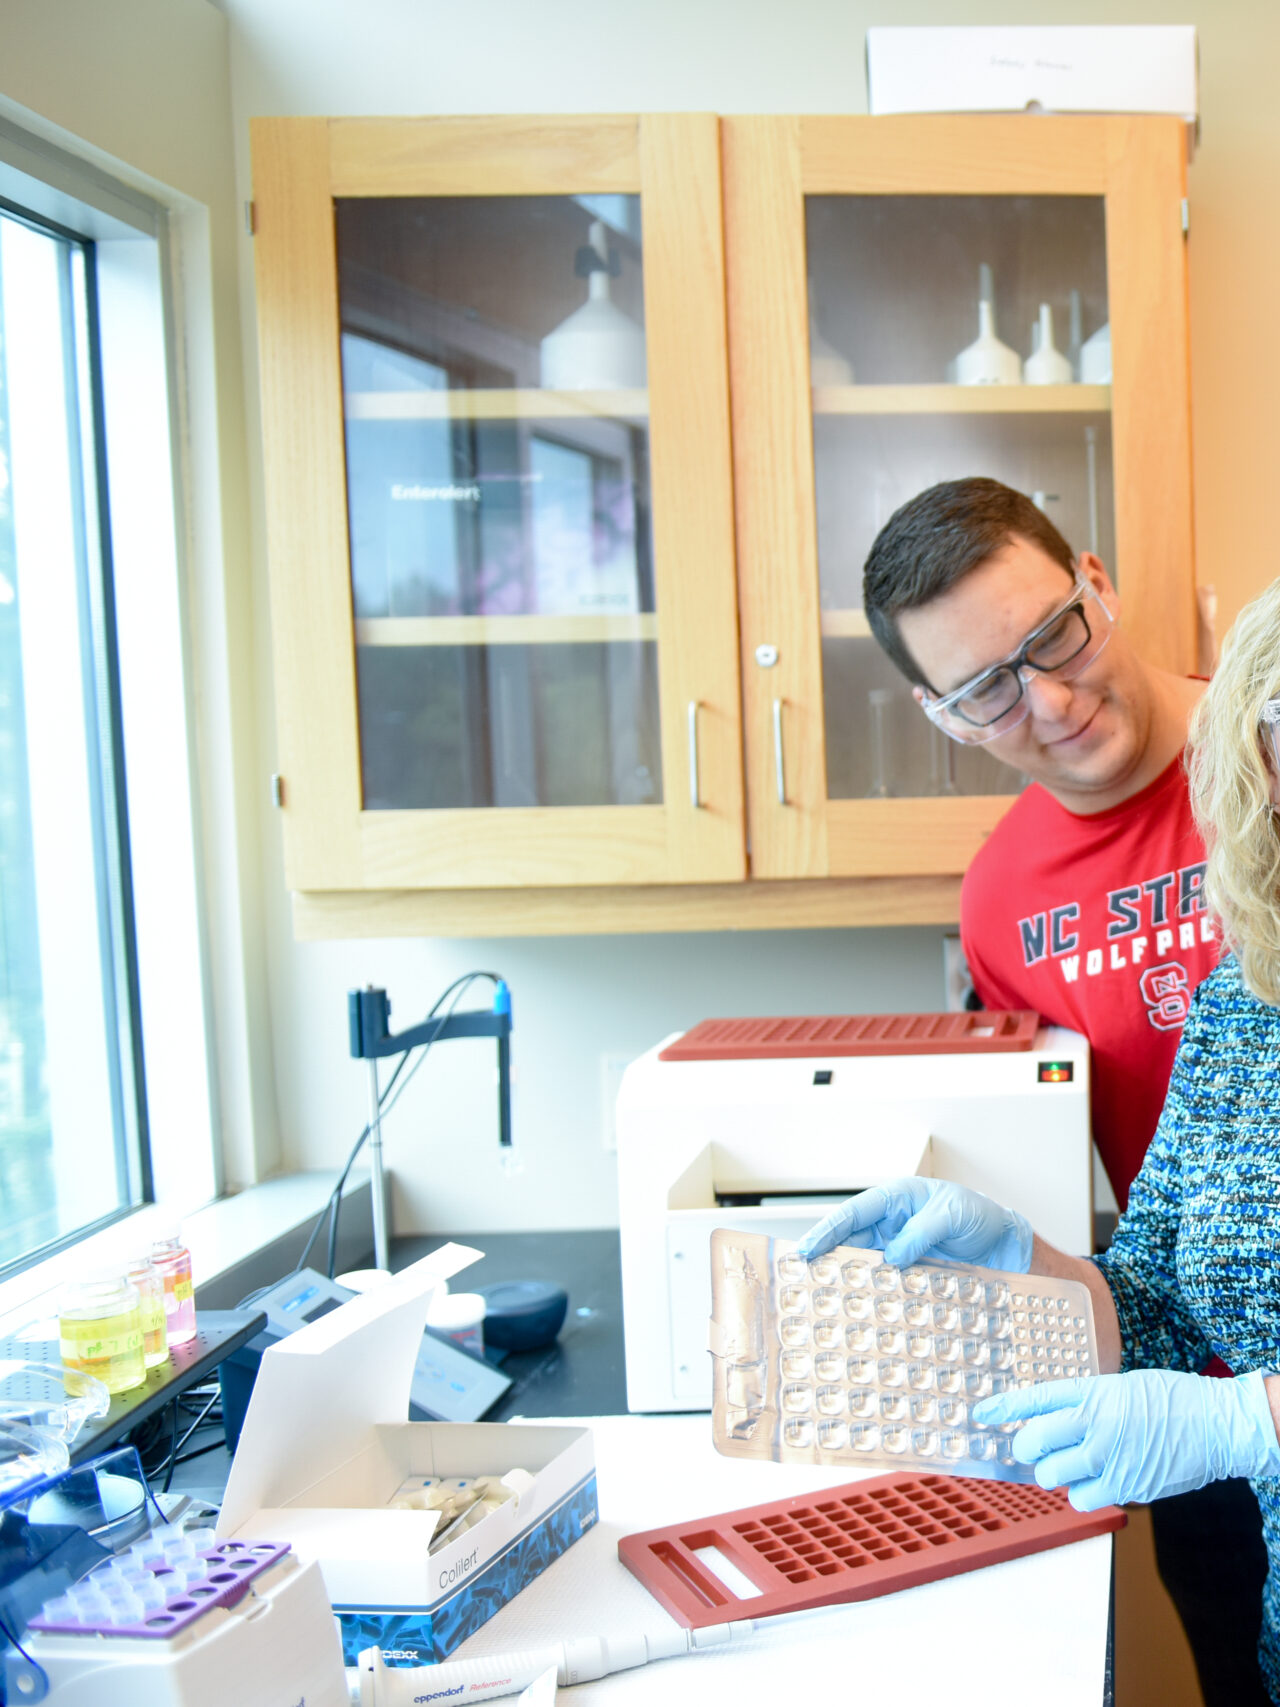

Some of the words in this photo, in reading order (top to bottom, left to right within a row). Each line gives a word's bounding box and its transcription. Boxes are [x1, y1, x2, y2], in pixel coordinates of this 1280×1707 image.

[1018, 902, 1080, 967] NC
[1106, 861, 1209, 940] STA
[1060, 917, 1216, 983] WOLFPAC
[438, 1549, 478, 1589] Colilert
[382, 1650, 419, 1660] DEXX
[413, 1684, 464, 1704] eppendorf
[469, 1678, 512, 1692] Reference
